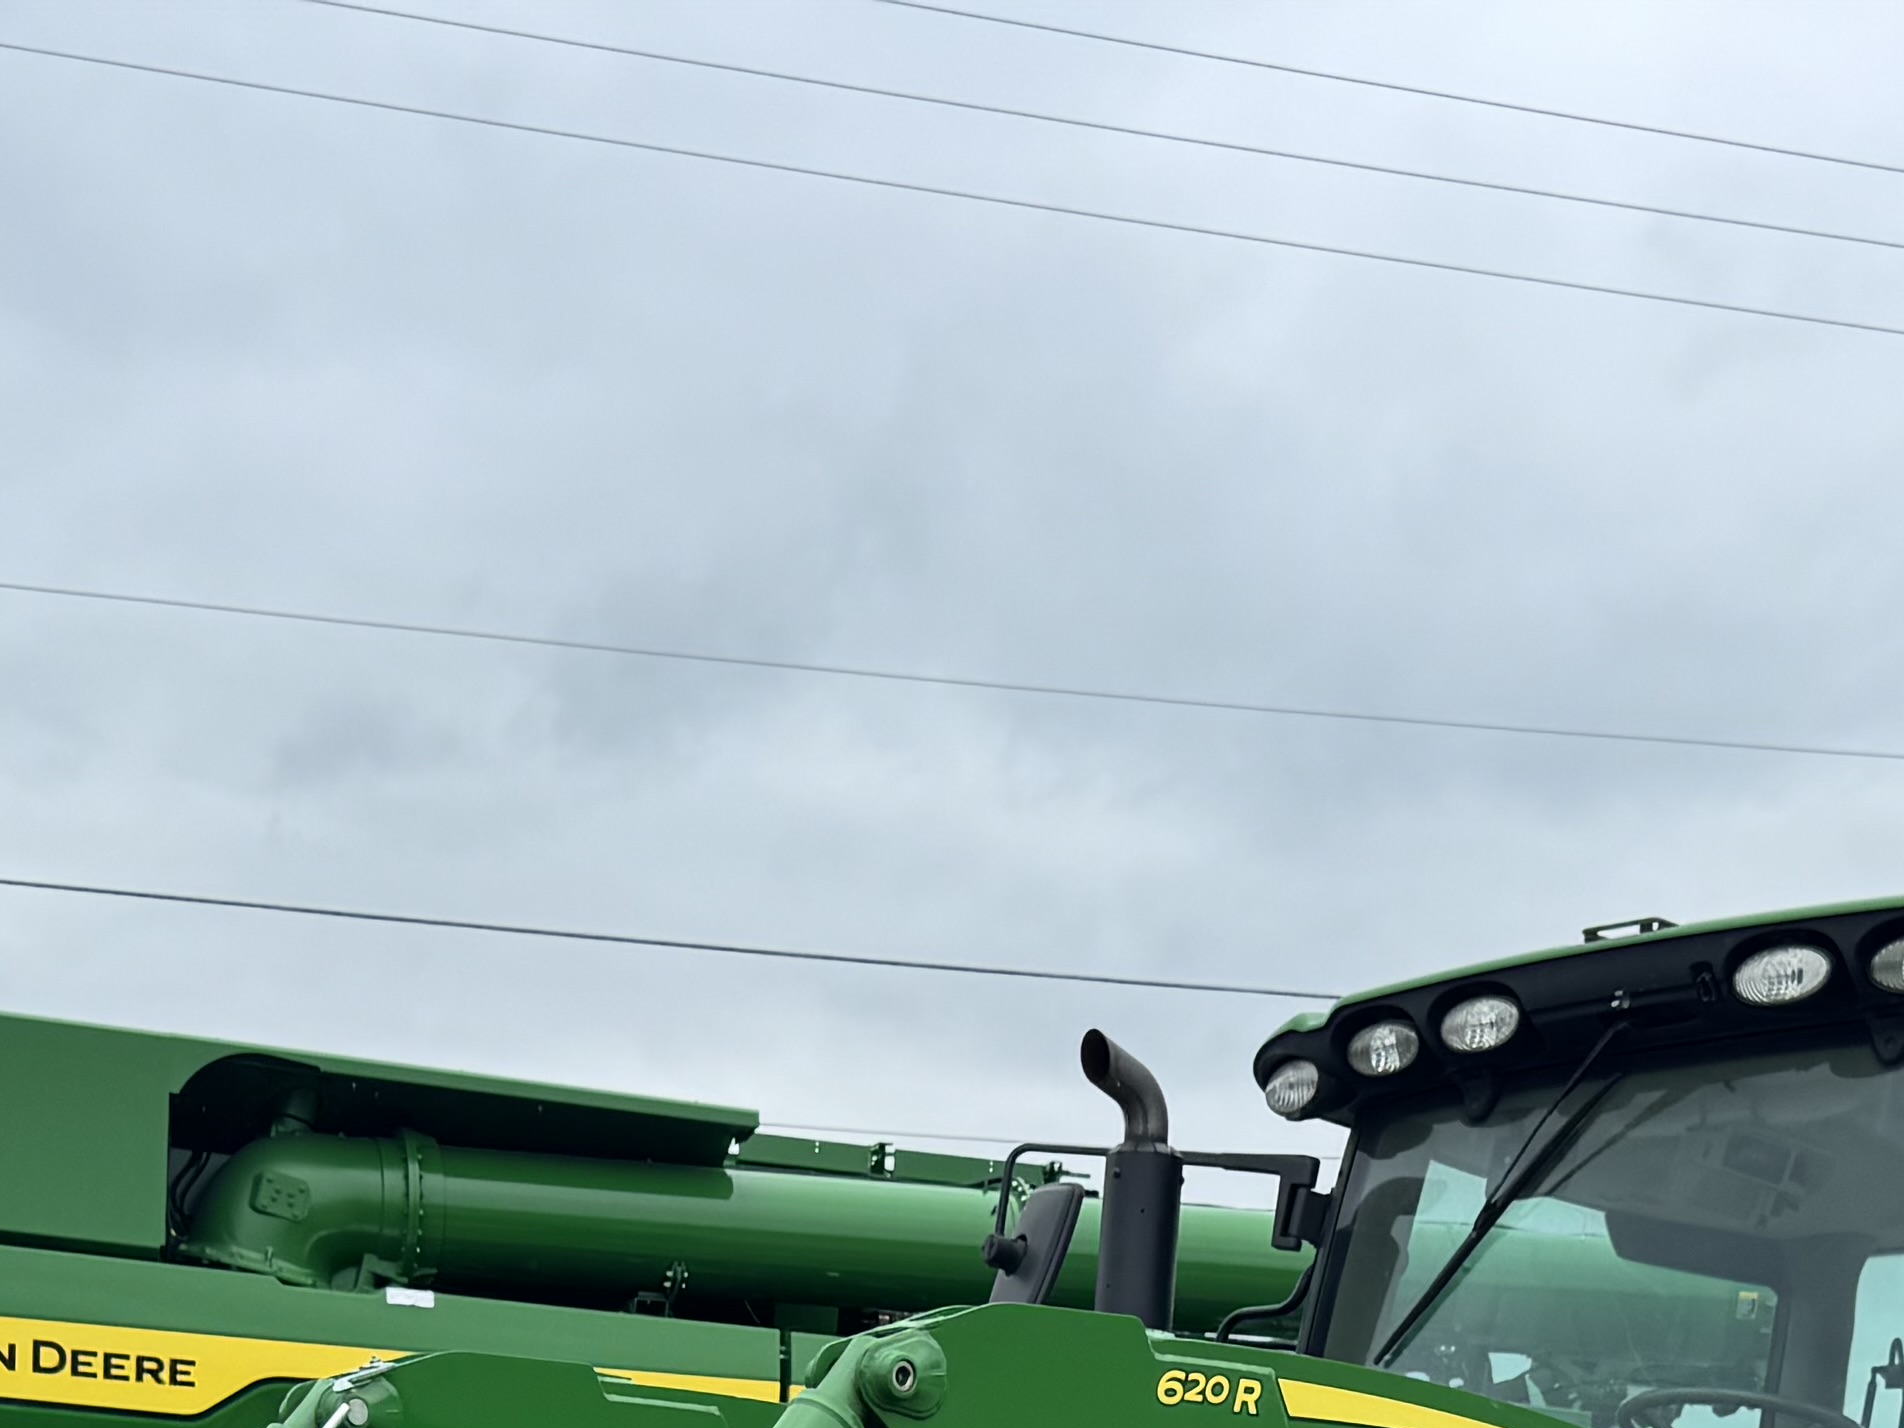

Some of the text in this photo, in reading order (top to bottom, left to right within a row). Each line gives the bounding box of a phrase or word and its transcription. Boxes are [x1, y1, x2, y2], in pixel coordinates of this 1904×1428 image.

[32, 1338, 197, 1387] DEERE
[1156, 1368, 1262, 1415] 620 R
